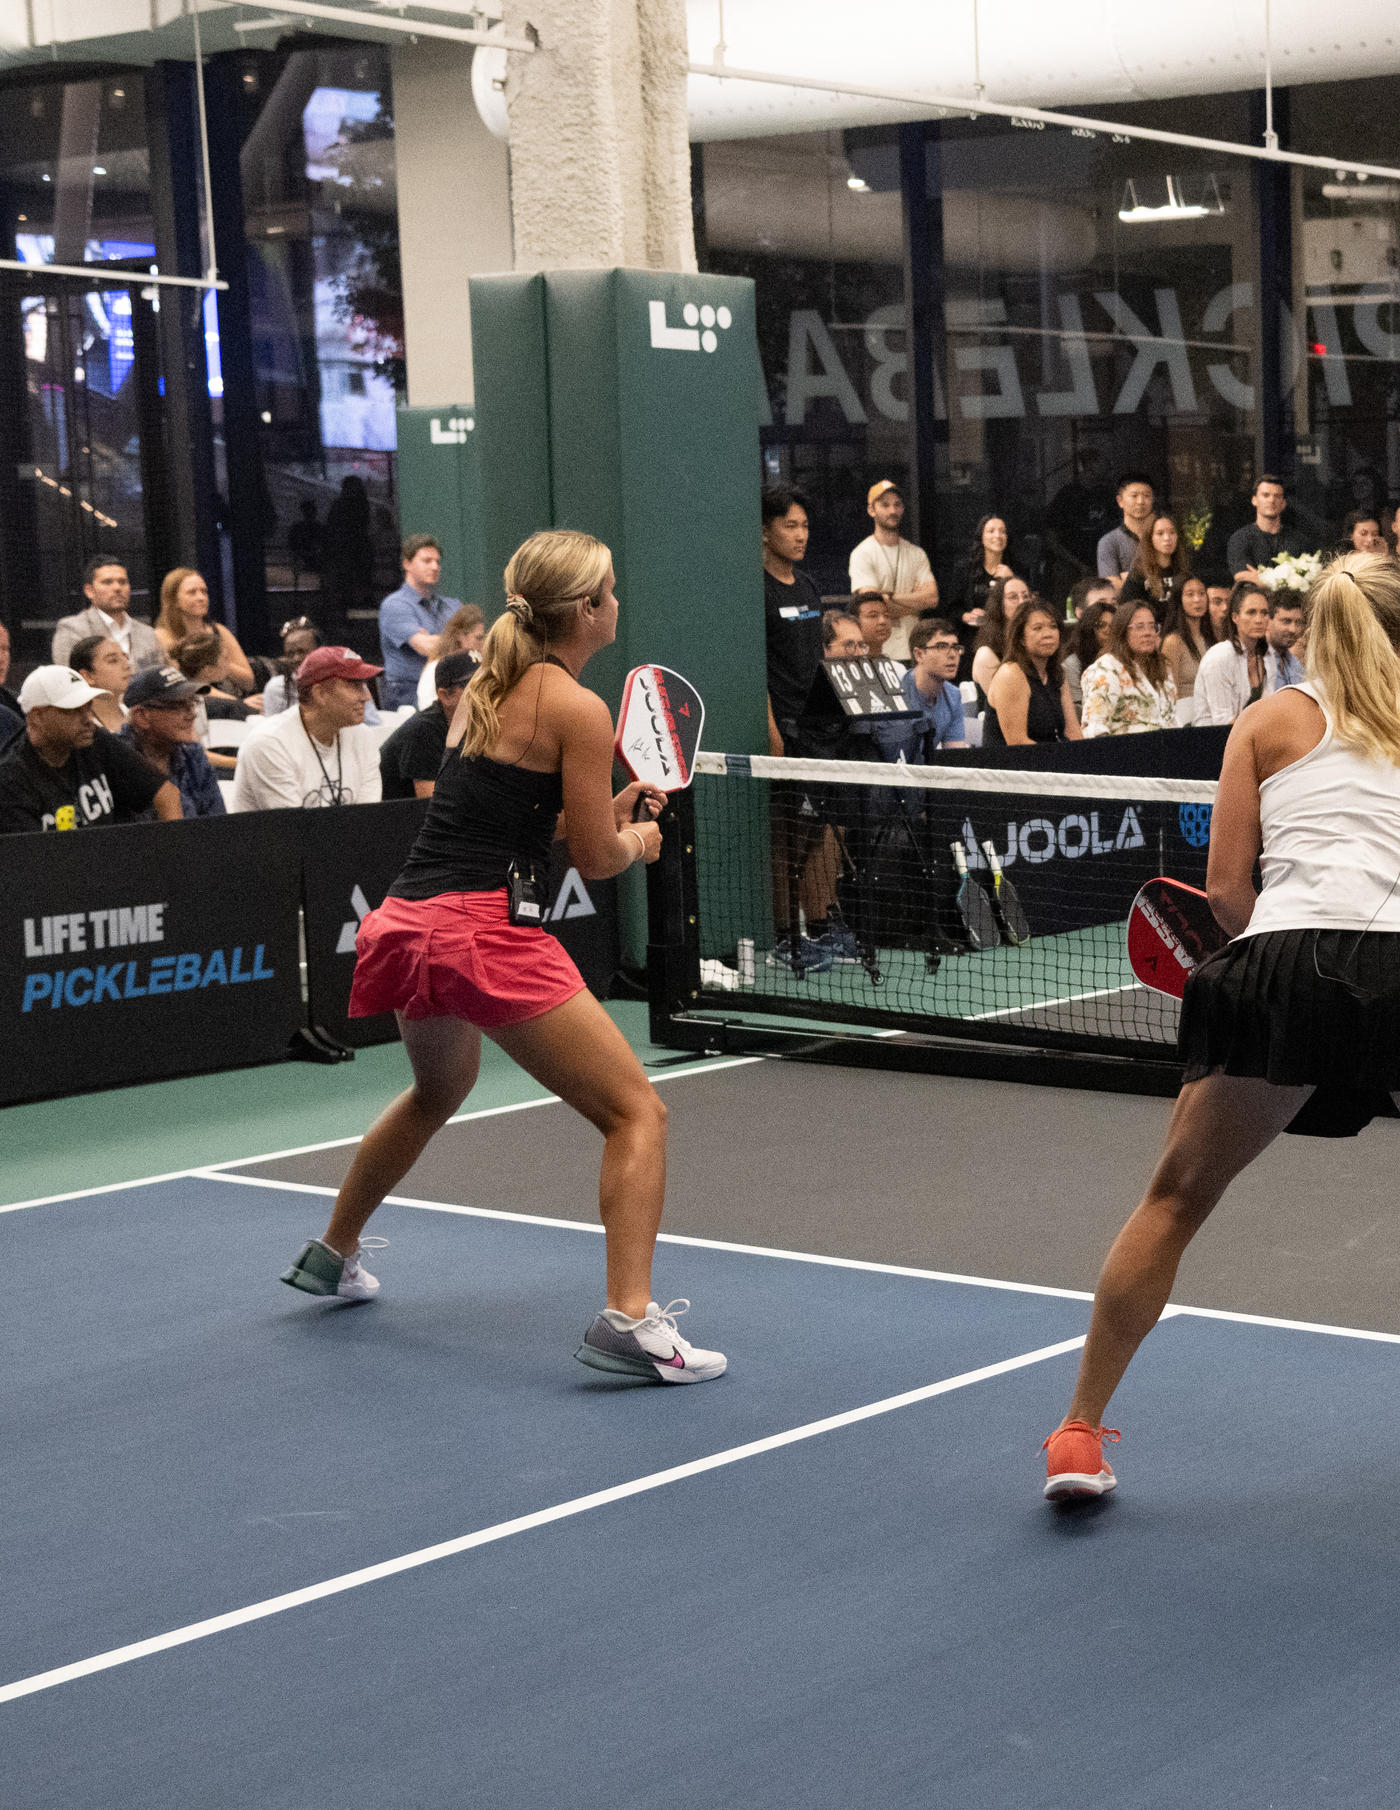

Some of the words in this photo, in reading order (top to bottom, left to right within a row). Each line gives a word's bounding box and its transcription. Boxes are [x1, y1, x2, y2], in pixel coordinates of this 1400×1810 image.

[831, 664, 853, 692] 13
[878, 661, 900, 689] 16
[998, 806, 1146, 868] JOOLA
[24, 912, 87, 958] LIFE
[89, 903, 164, 949] TIME
[21, 944, 274, 1013] PICKLEBALL
